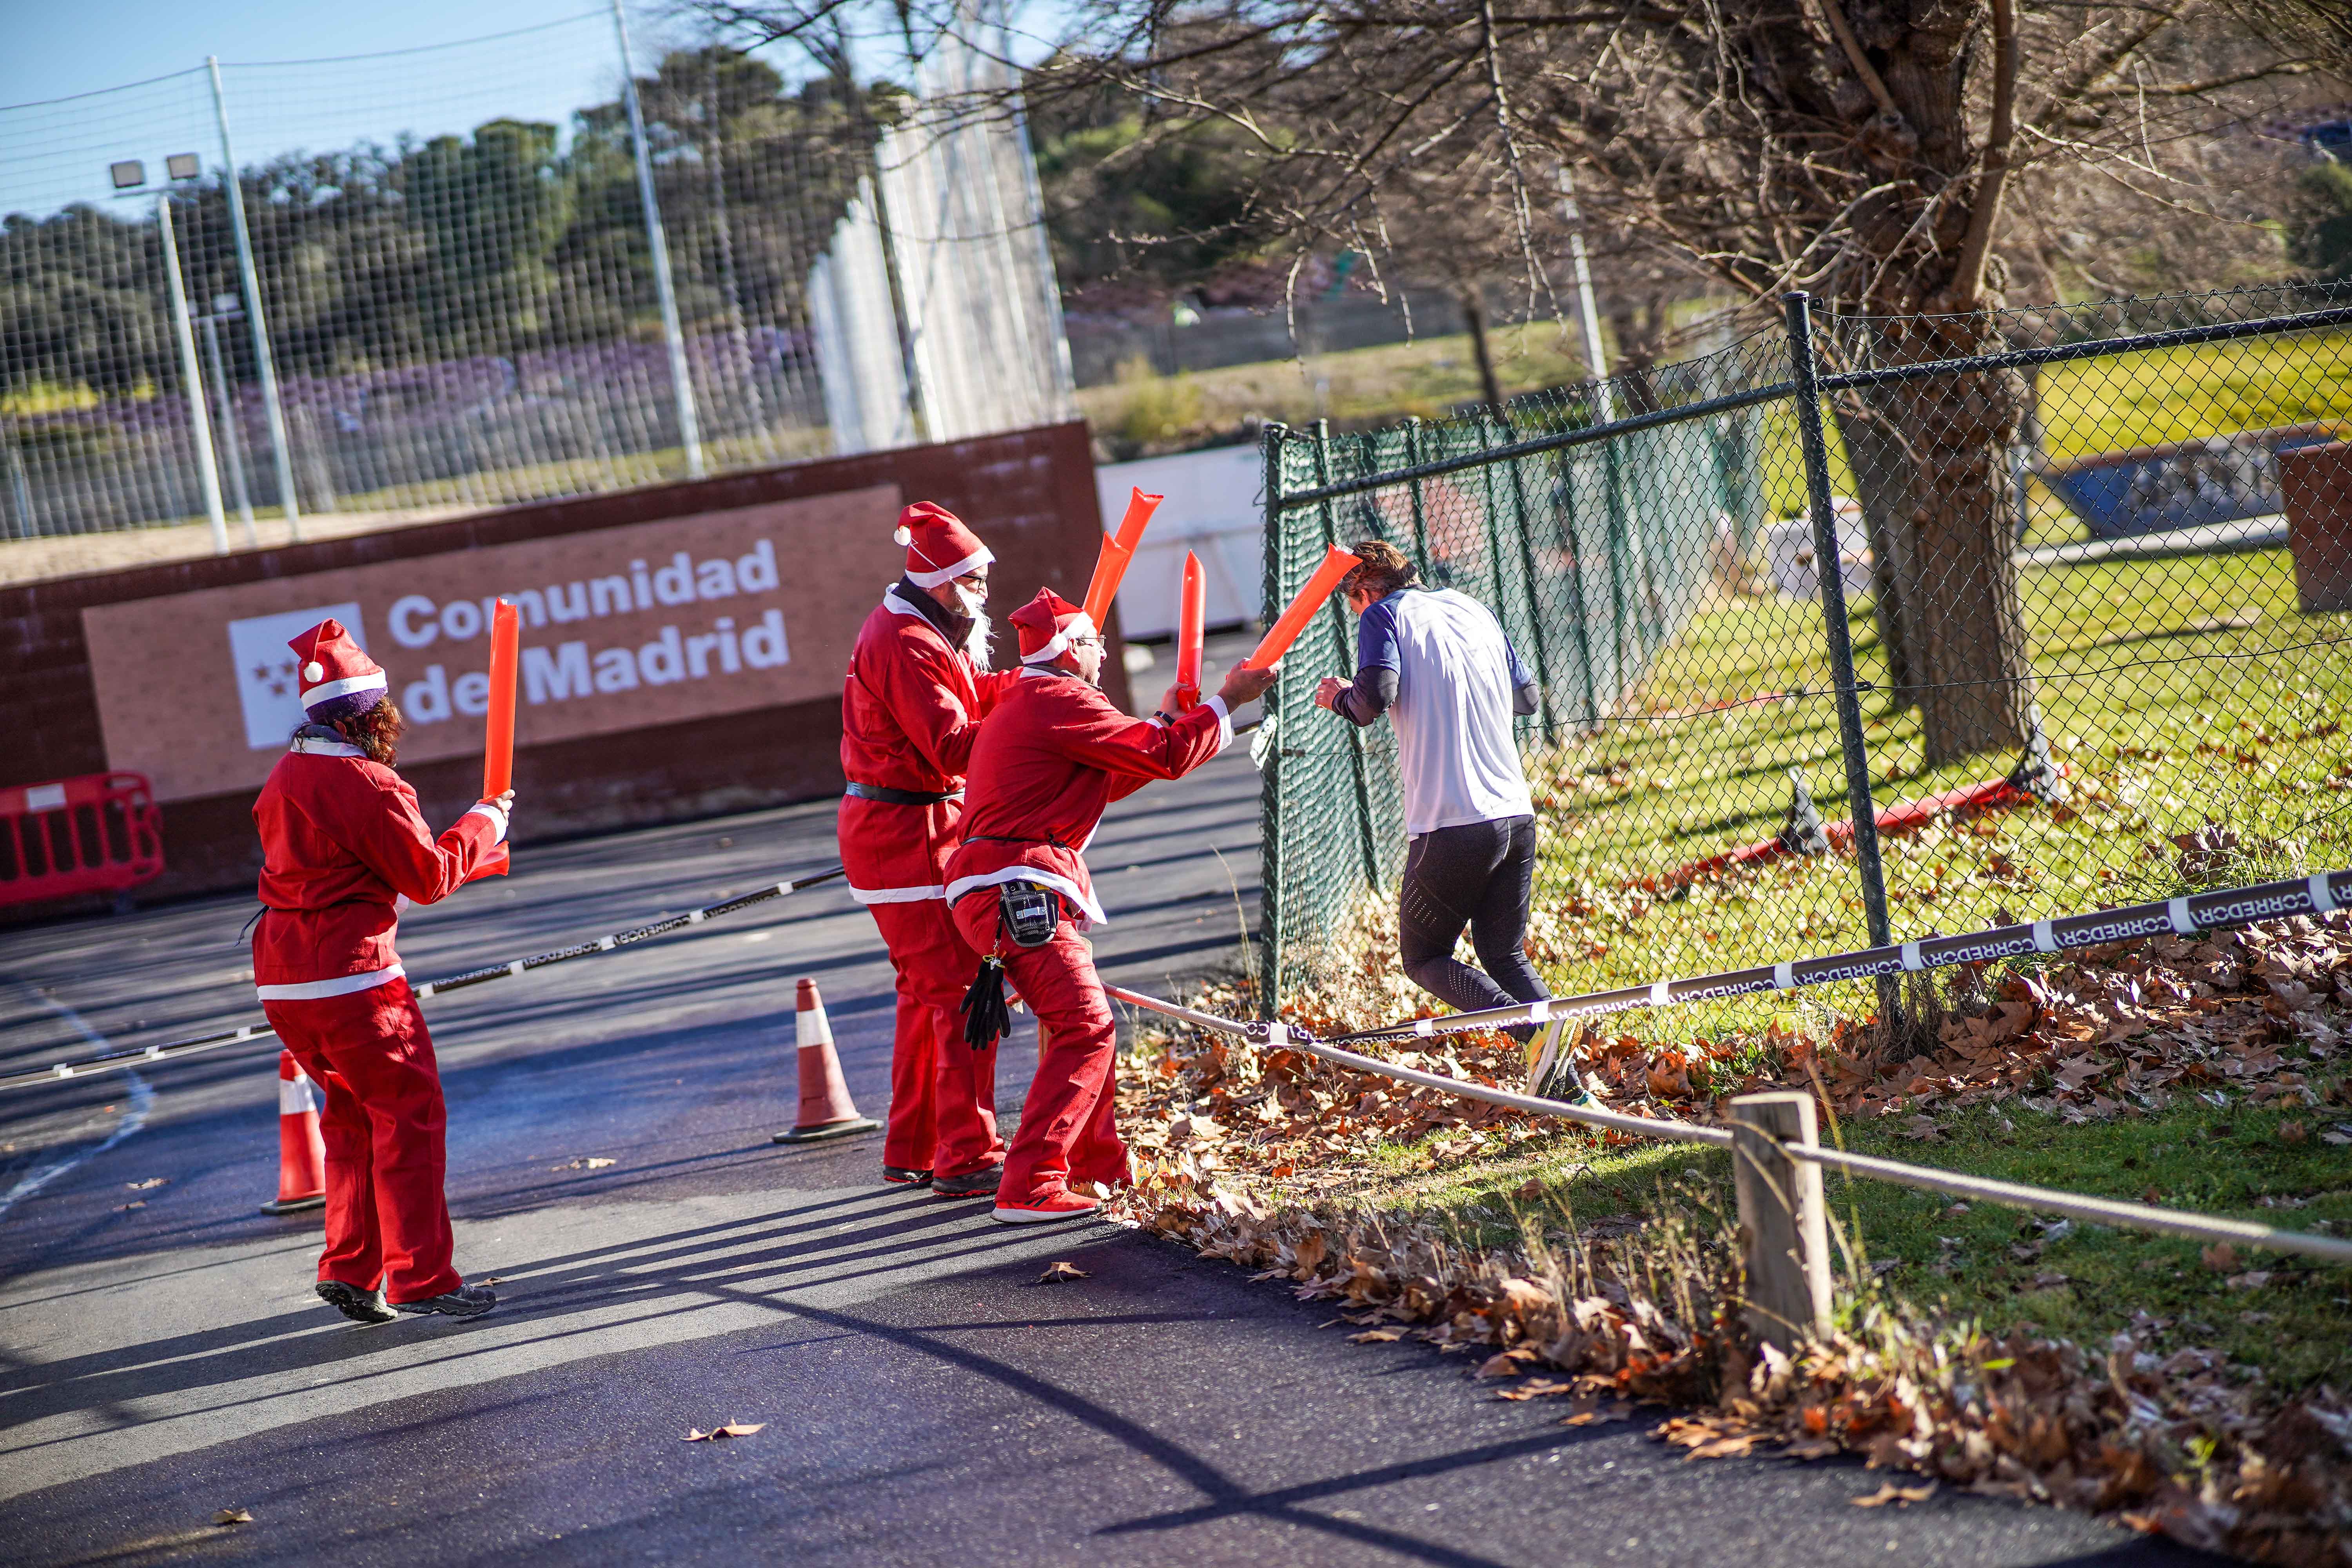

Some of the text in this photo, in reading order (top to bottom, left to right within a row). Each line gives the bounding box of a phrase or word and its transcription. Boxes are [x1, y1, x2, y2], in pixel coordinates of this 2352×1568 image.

[388, 539, 780, 648] Comunidad
[402, 664, 489, 725] de
[522, 609, 790, 704] Madrid
